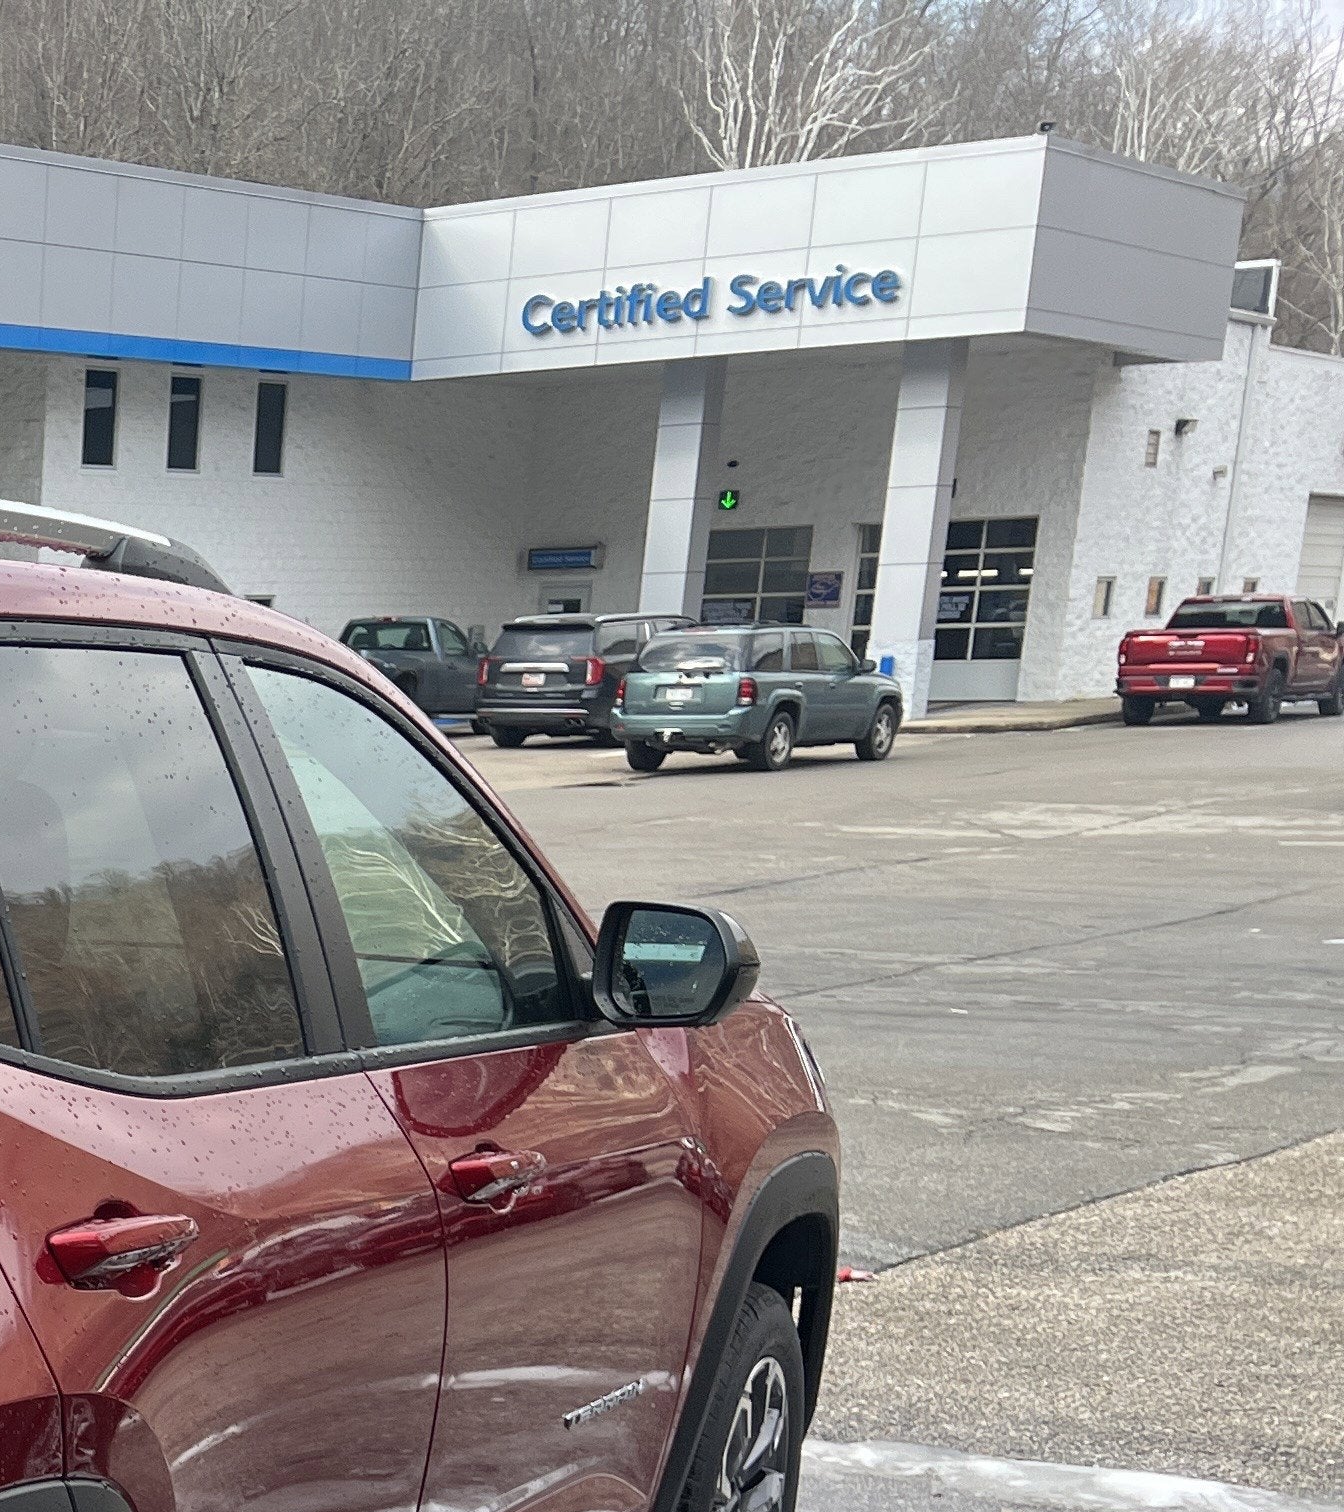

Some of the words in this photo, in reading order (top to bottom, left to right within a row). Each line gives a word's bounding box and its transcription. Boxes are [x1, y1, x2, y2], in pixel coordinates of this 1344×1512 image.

[521, 276, 712, 336] Certified
[726, 264, 903, 317] Service
[562, 1378, 647, 1427] TERRAIN
